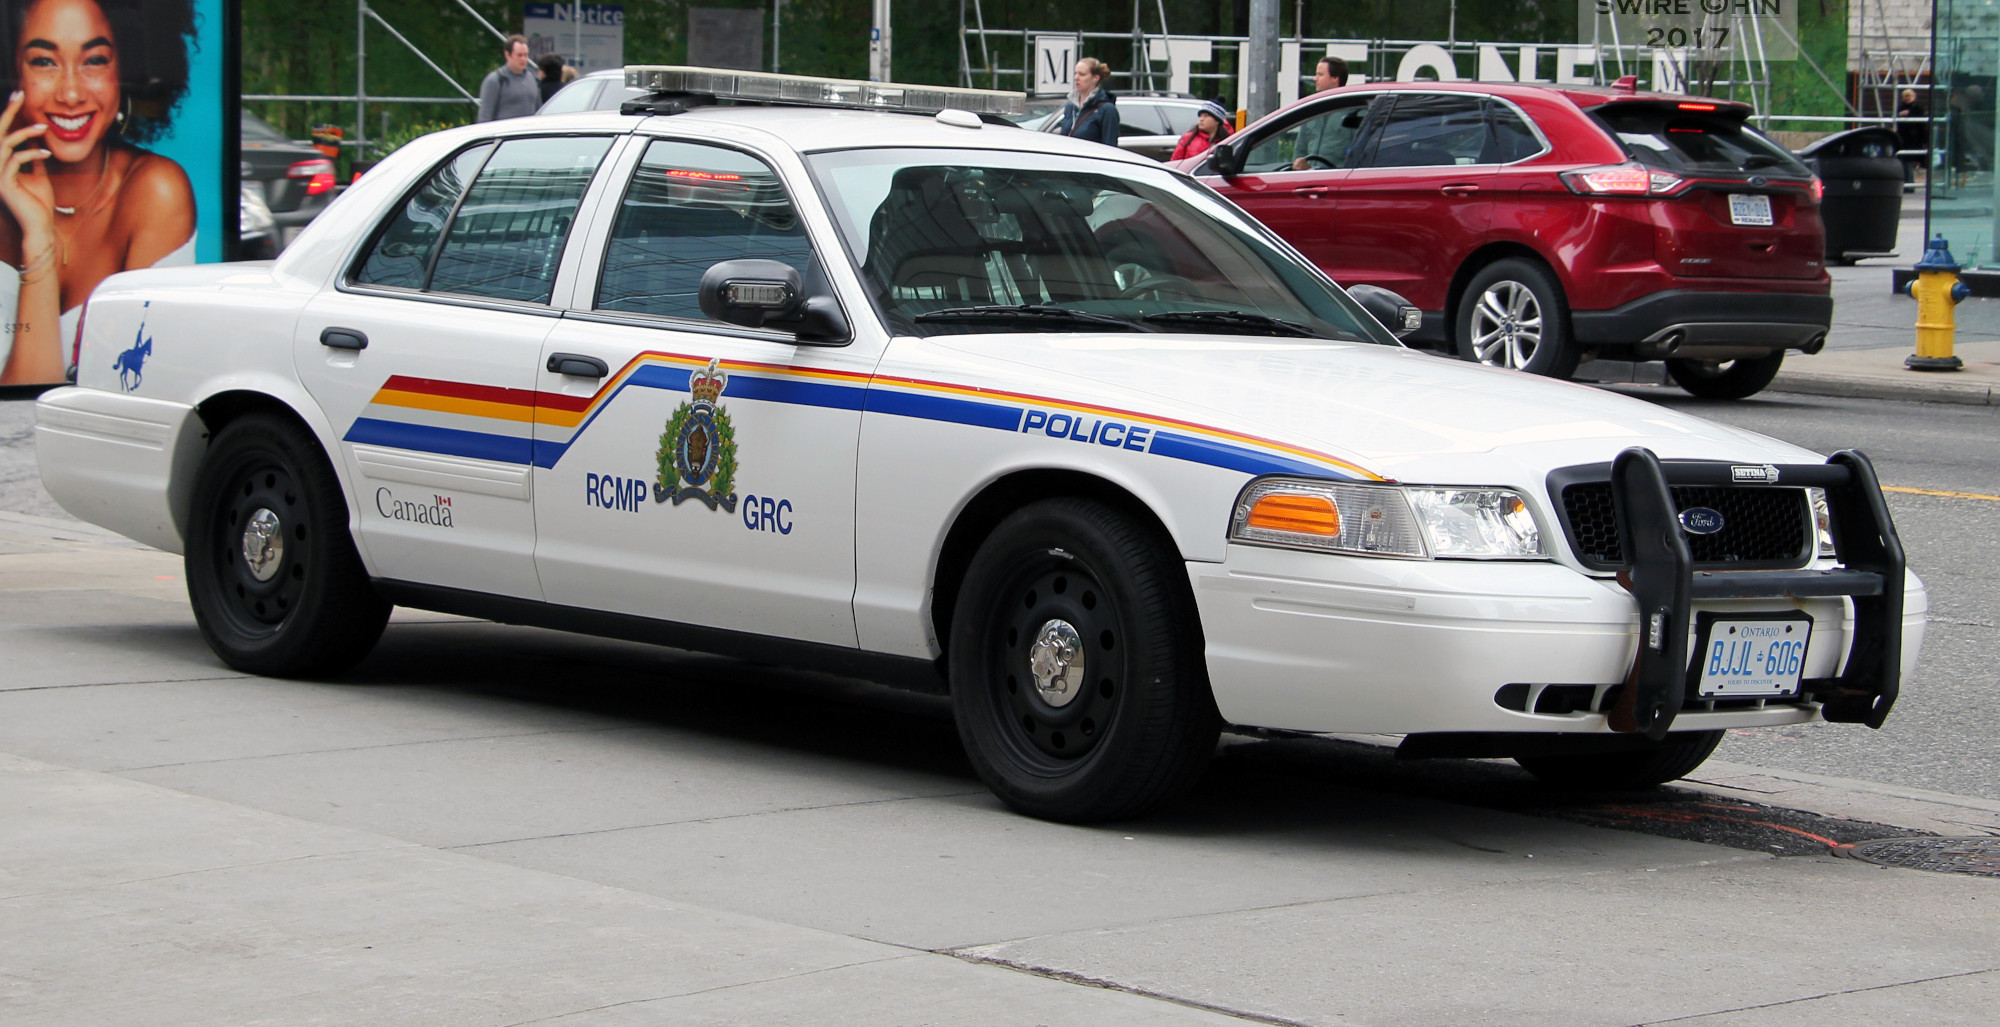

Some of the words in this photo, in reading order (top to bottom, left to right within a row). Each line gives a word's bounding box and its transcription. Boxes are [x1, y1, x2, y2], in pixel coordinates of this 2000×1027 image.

[1043, 49, 1071, 84] M
[1022, 410, 1151, 452] POLICE
[1734, 468, 1766, 477] SETINA
[376, 486, 454, 528] Canada
[586, 472, 648, 513] RCMP
[742, 494, 794, 535] GRC
[1690, 512, 1715, 527] Ford
[1708, 640, 1753, 676] BJJL
[1764, 640, 1803, 675] 606
